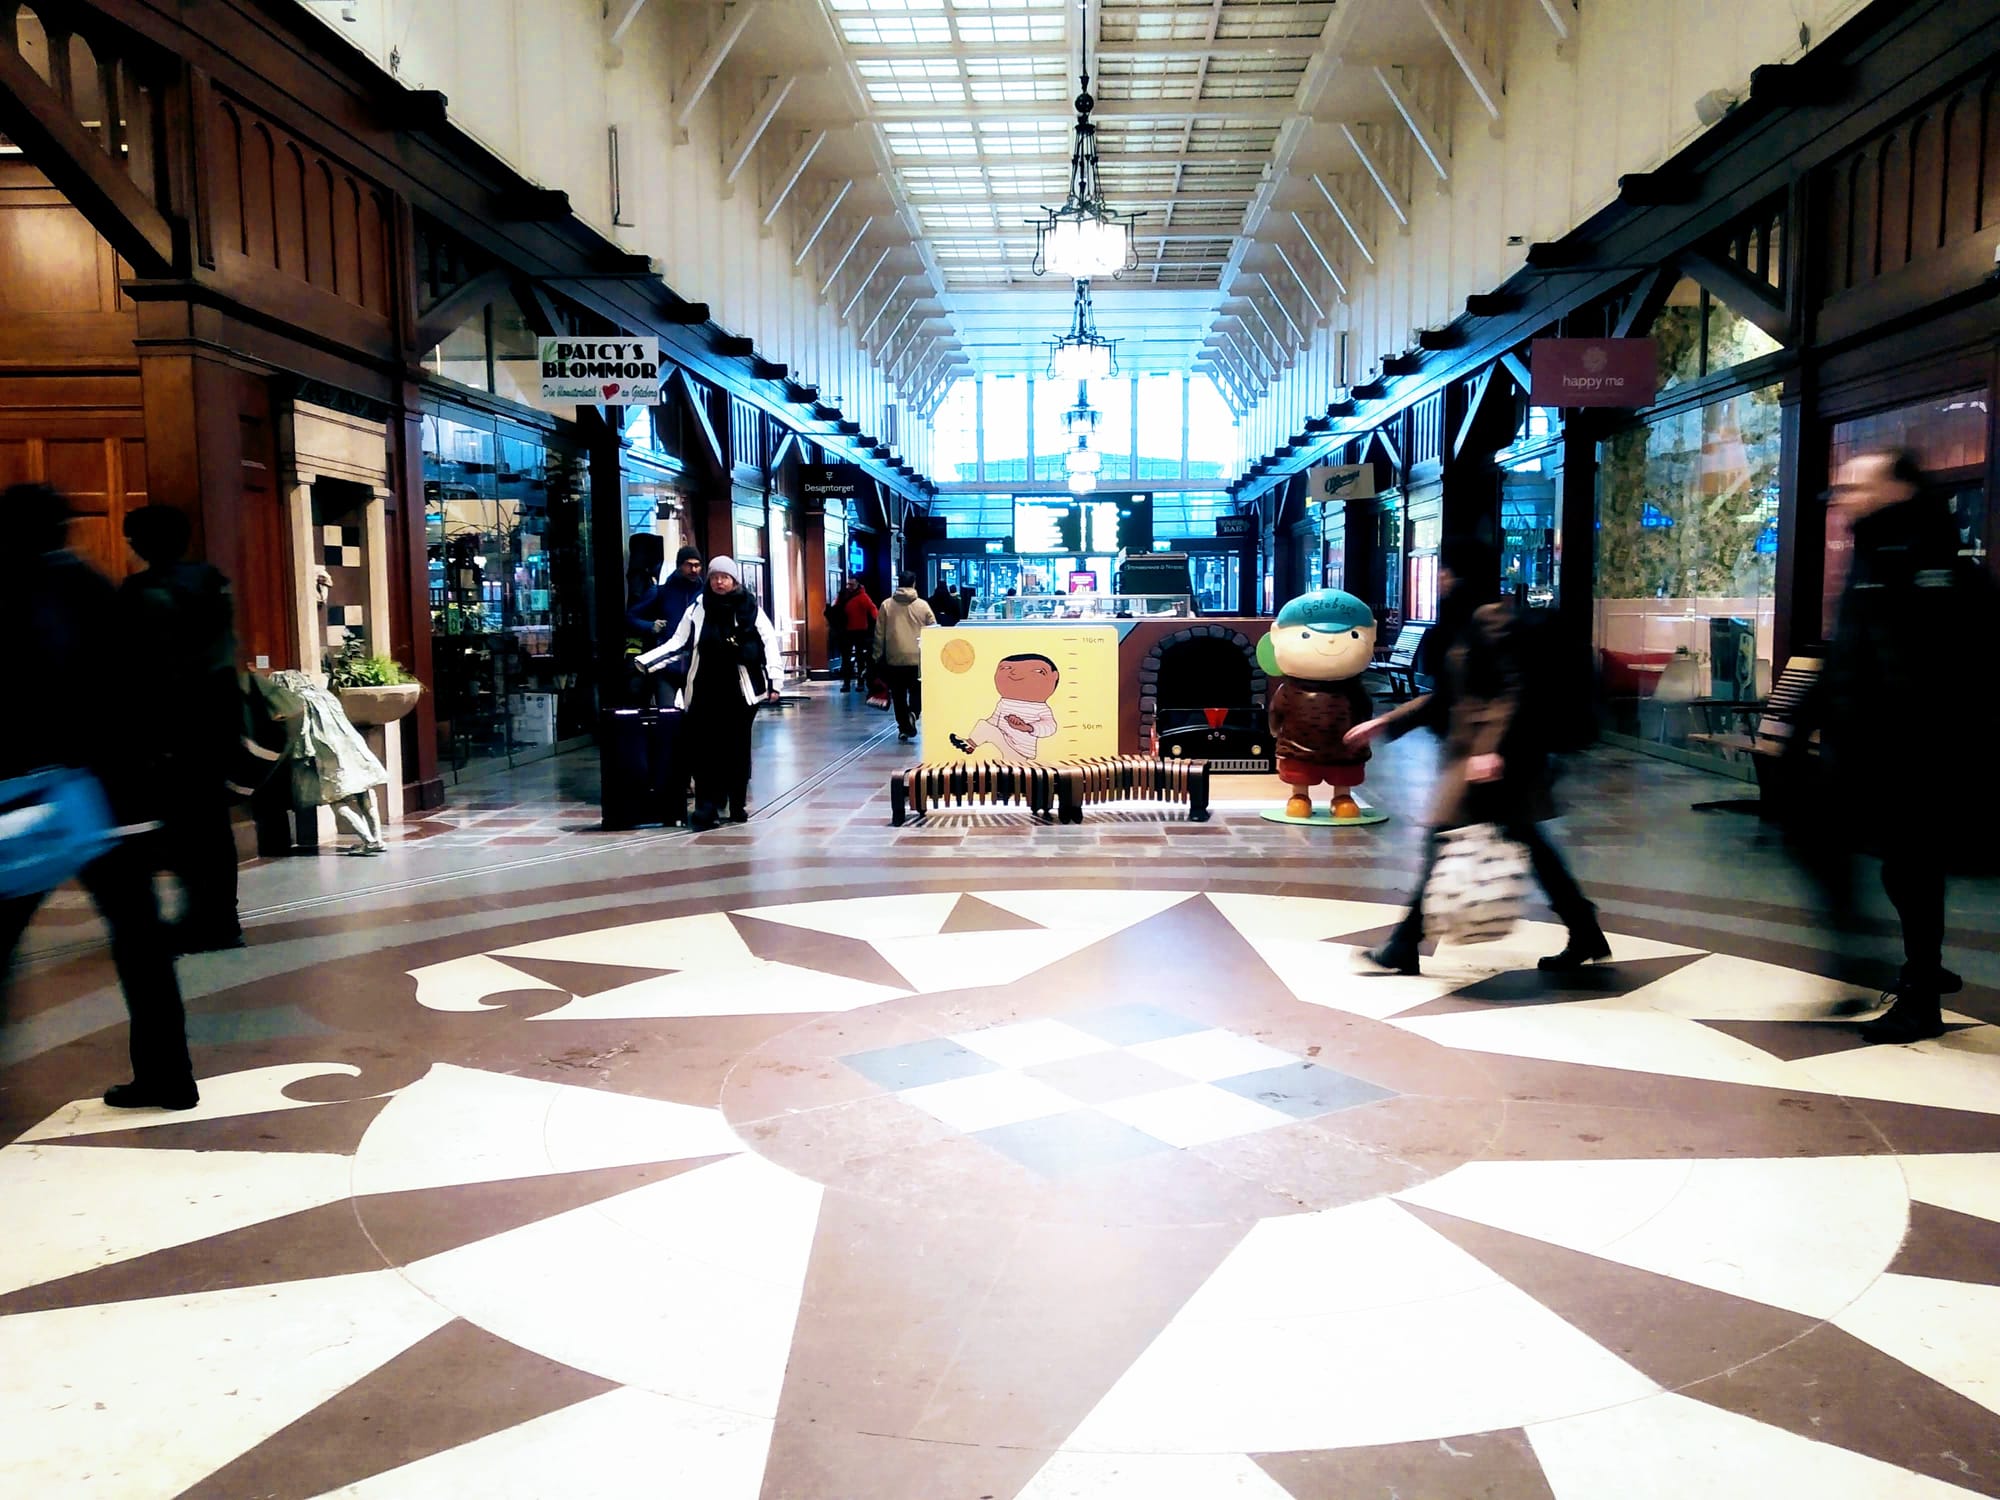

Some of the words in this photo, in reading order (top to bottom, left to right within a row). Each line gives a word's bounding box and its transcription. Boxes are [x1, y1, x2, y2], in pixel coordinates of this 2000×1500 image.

[557, 344, 644, 360] PATCY'S
[542, 362, 658, 378] BLOMMOR
[1562, 375, 1602, 389] happy
[1605, 376, 1625, 387] me
[804, 483, 854, 493] Designtorget
